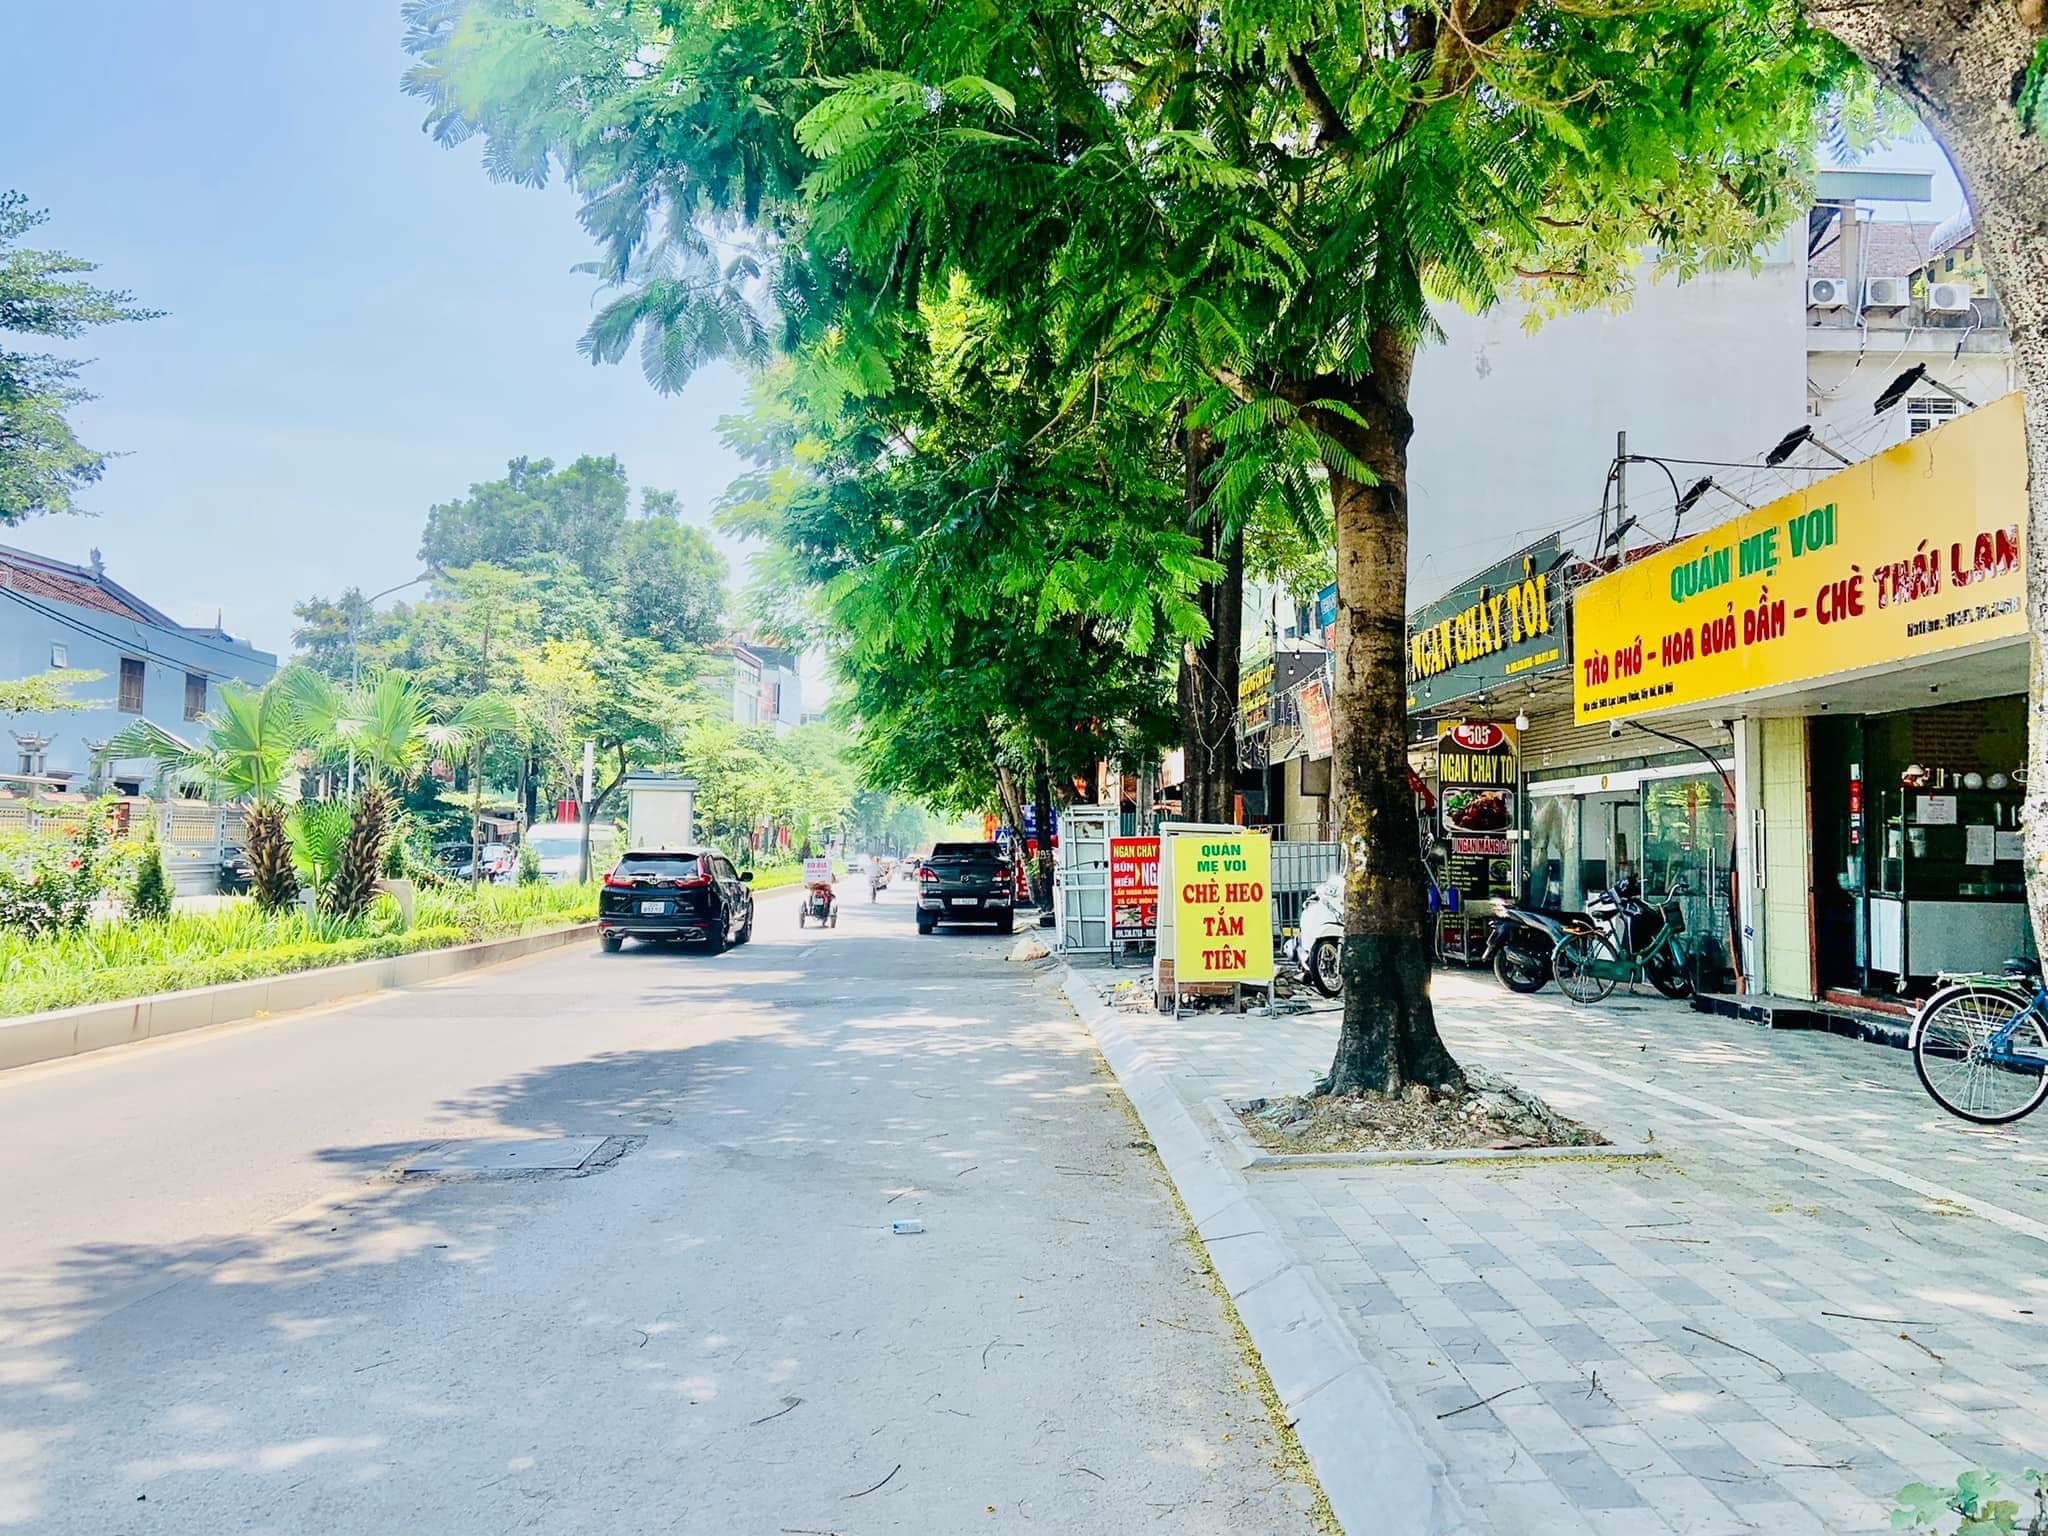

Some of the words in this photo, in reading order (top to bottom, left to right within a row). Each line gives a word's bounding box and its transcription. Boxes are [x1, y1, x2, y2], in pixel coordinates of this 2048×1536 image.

[1670, 545, 1731, 604] QUÁN
[1738, 526, 1779, 577] MẸ
[1788, 503, 1836, 558] VOI
[1411, 615, 1453, 683] NGAN
[1455, 584, 1502, 665] CHÁY
[1507, 553, 1550, 643] TỎI
[1583, 648, 1609, 688] TÀO
[1614, 635, 1642, 680] PHỚ
[1662, 627, 1695, 668] HOA
[1700, 601, 1736, 657] QUẢ
[1816, 564, 1864, 625] CHÈ
[1872, 538, 1941, 610] THÁI
[1950, 524, 2021, 588] LAN
[1467, 725, 1489, 745] 505
[1440, 753, 1469, 783] NGAN
[1471, 749, 1498, 784] CHÁY
[1113, 845, 1135, 858] NGAN
[1136, 843, 1157, 858] CHÁY
[1201, 842, 1241, 857] QUÁN
[1141, 862, 1160, 887] NG
[1197, 860, 1219, 875] MẸ
[1224, 860, 1247, 872] VOI
[1182, 877, 1220, 904] CHÈ
[1225, 882, 1264, 903] HEO
[1203, 906, 1244, 937] TẮM
[1202, 944, 1247, 970] TIÊN
